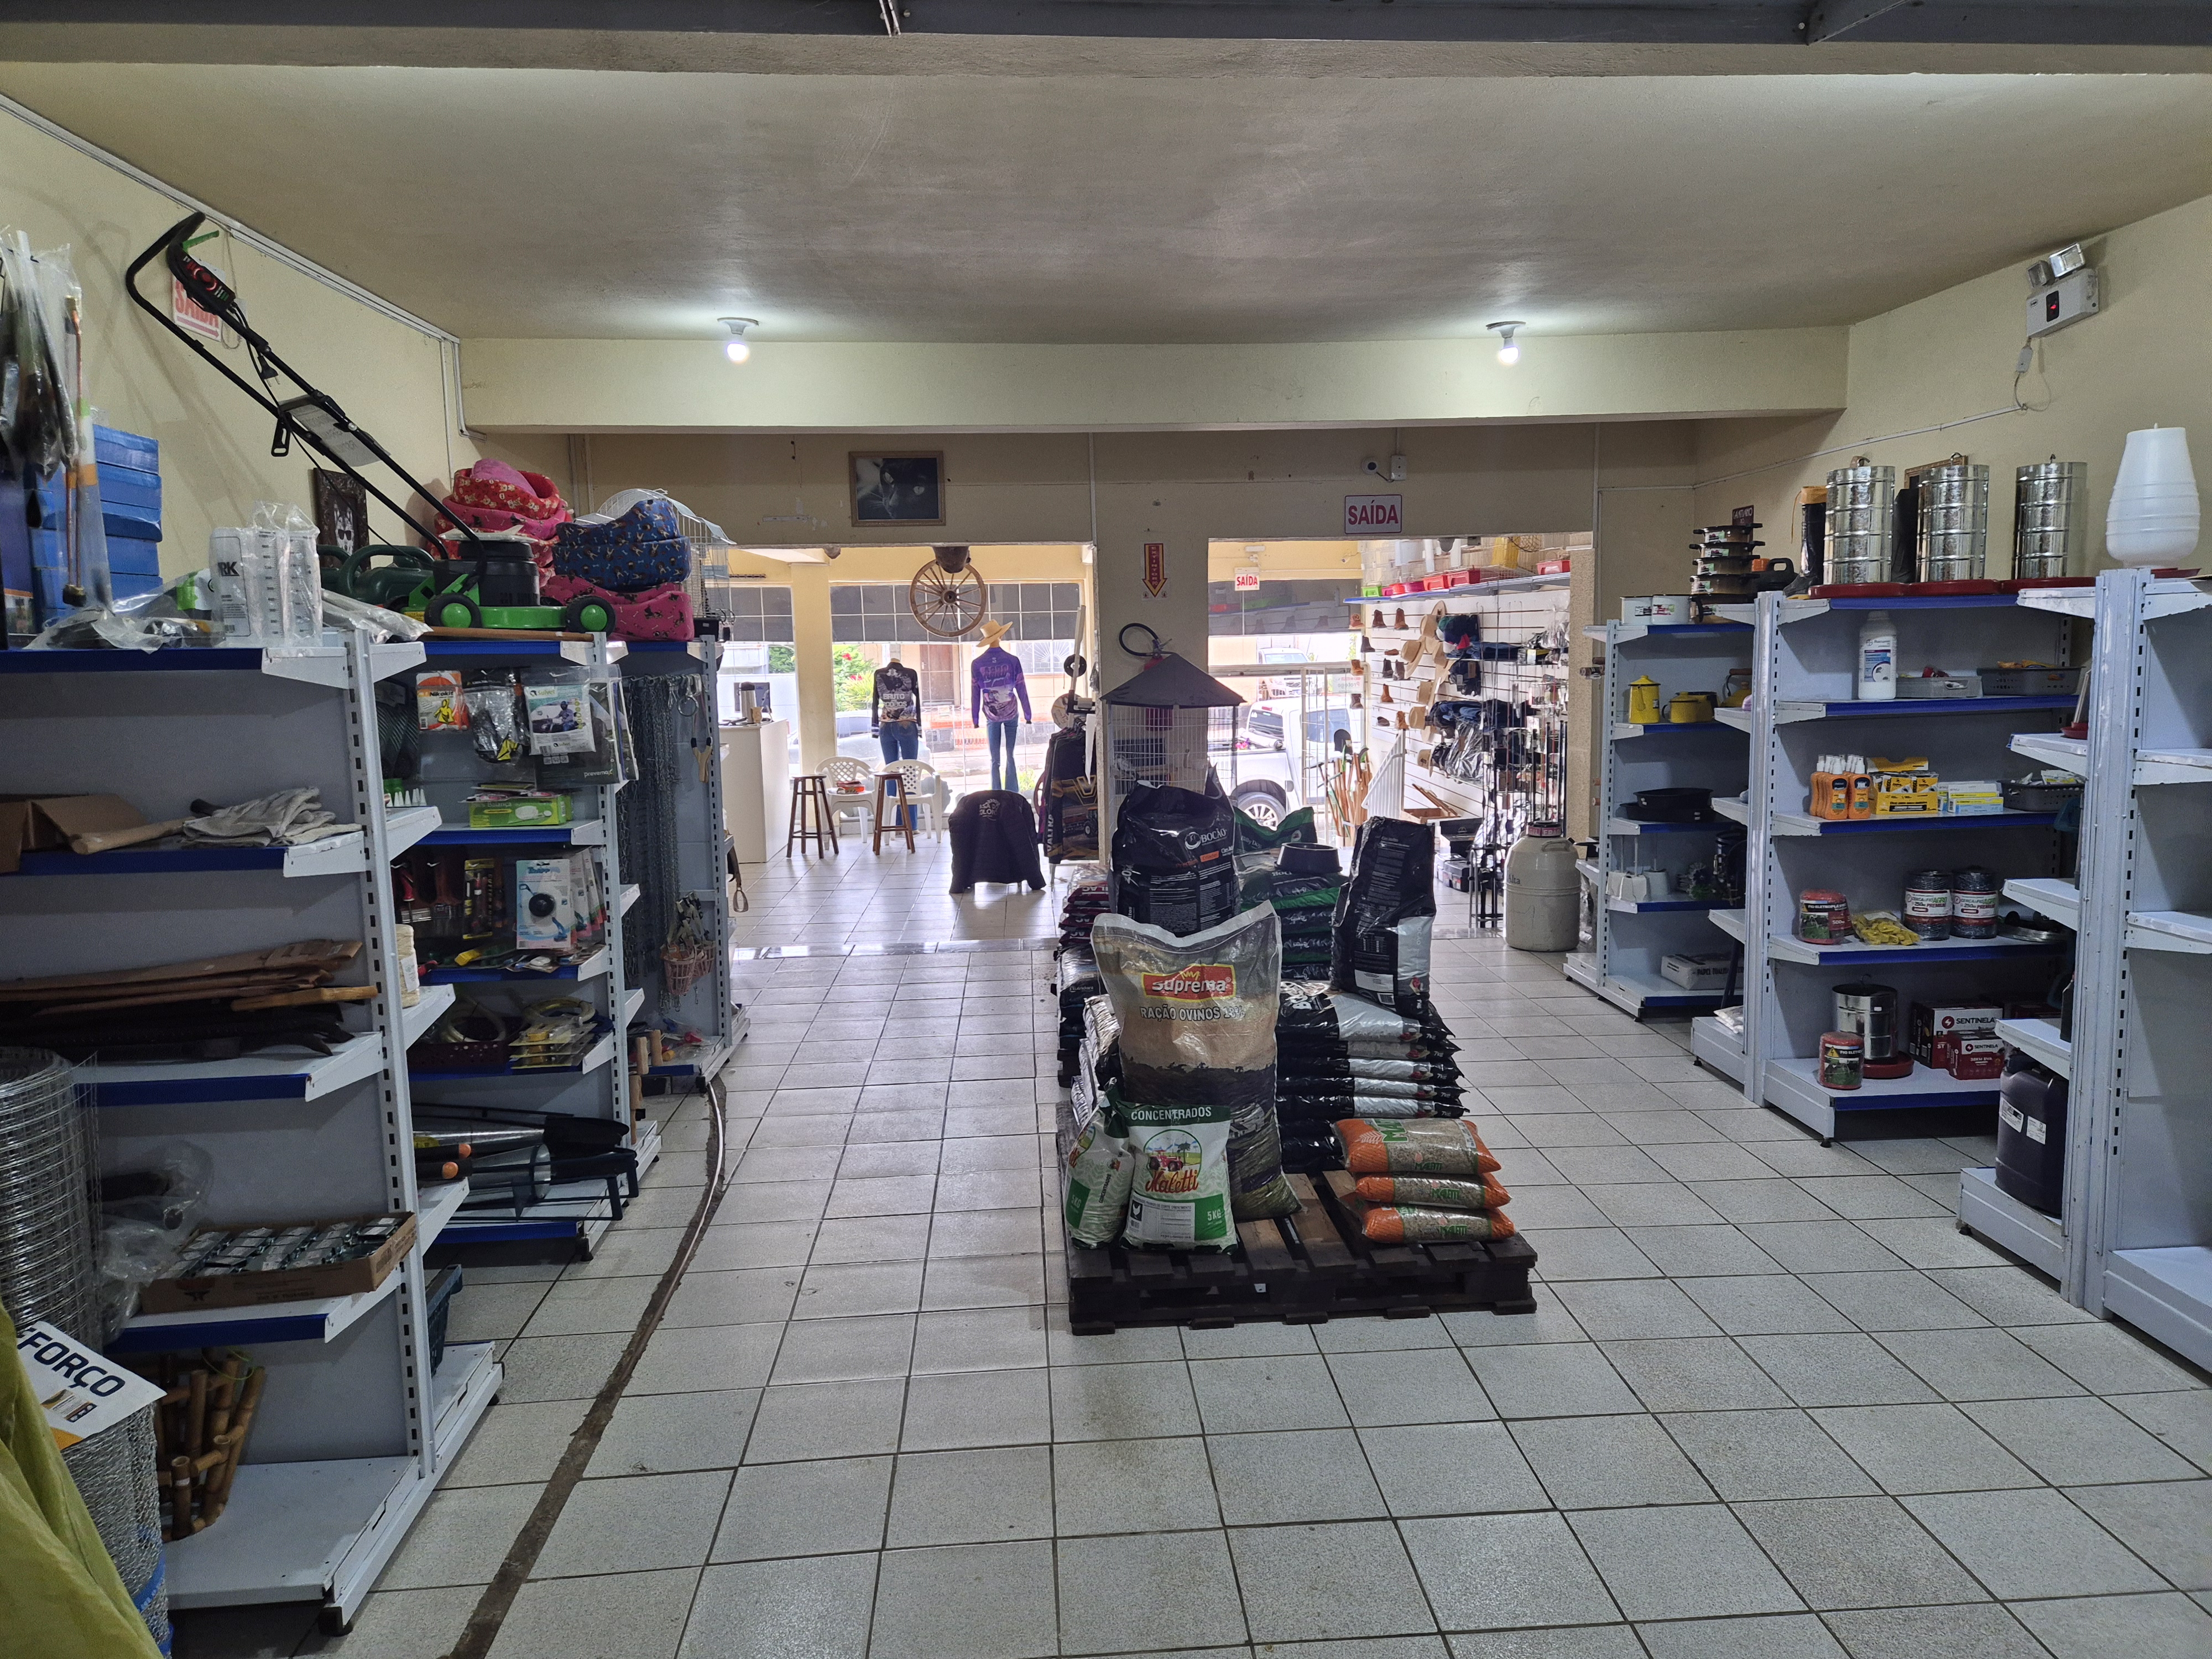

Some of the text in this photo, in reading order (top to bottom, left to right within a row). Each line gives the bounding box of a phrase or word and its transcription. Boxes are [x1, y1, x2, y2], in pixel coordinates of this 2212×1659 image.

[1348, 499, 1399, 525] SAÍDA
[1237, 574, 1258, 586] SAÍDA
[1201, 828, 1227, 843] BOCÃO
[1140, 1004, 1176, 1022] RAÇÃO
[1179, 1006, 1221, 1021] OVINOS
[1131, 1106, 1212, 1120] CONCENTRADOS
[1145, 1169, 1198, 1193] Maletti
[1207, 1209, 1222, 1221] 5KG
